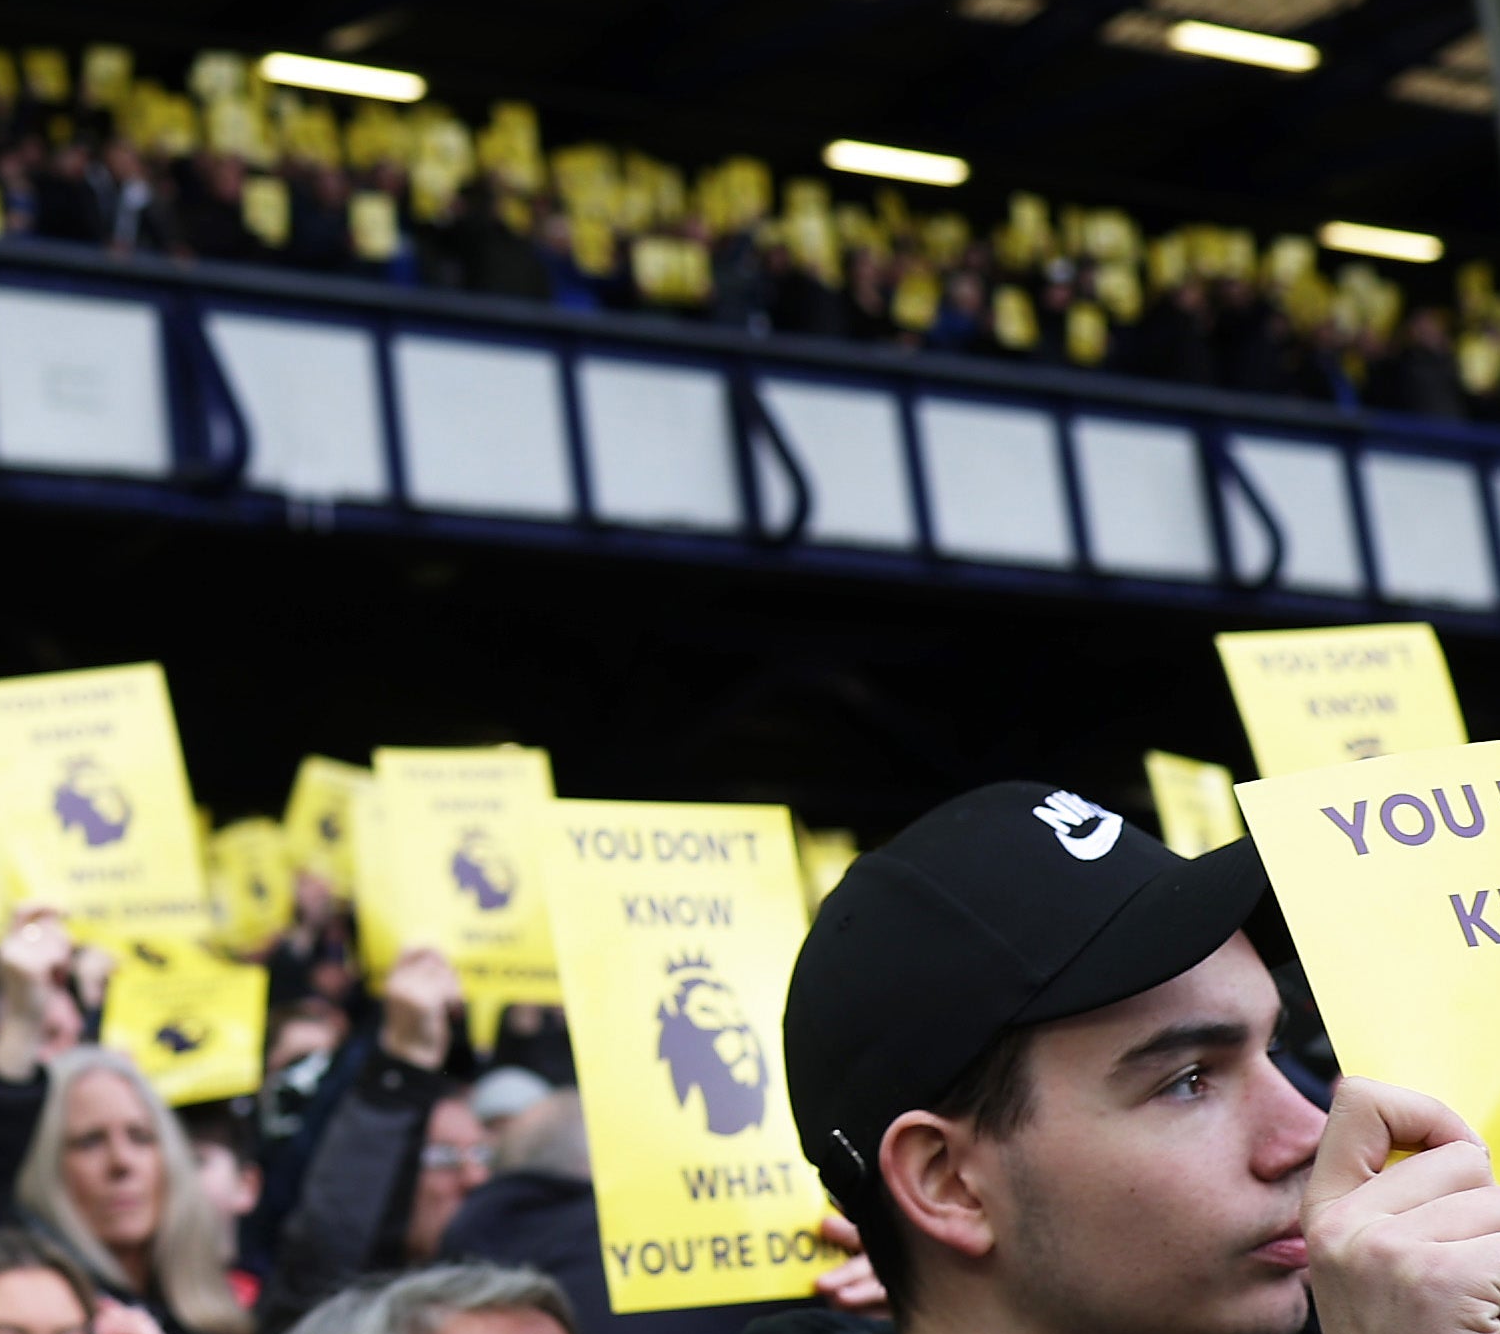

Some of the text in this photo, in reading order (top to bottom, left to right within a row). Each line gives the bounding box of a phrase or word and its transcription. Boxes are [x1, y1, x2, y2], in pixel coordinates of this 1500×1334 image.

[1320, 780, 1488, 856] YOU
[566, 827, 759, 864] YOU DON'T
[621, 893, 734, 927] KNOW
[681, 1164, 796, 1201] WHAT
[609, 1232, 754, 1278] YOU'RE
